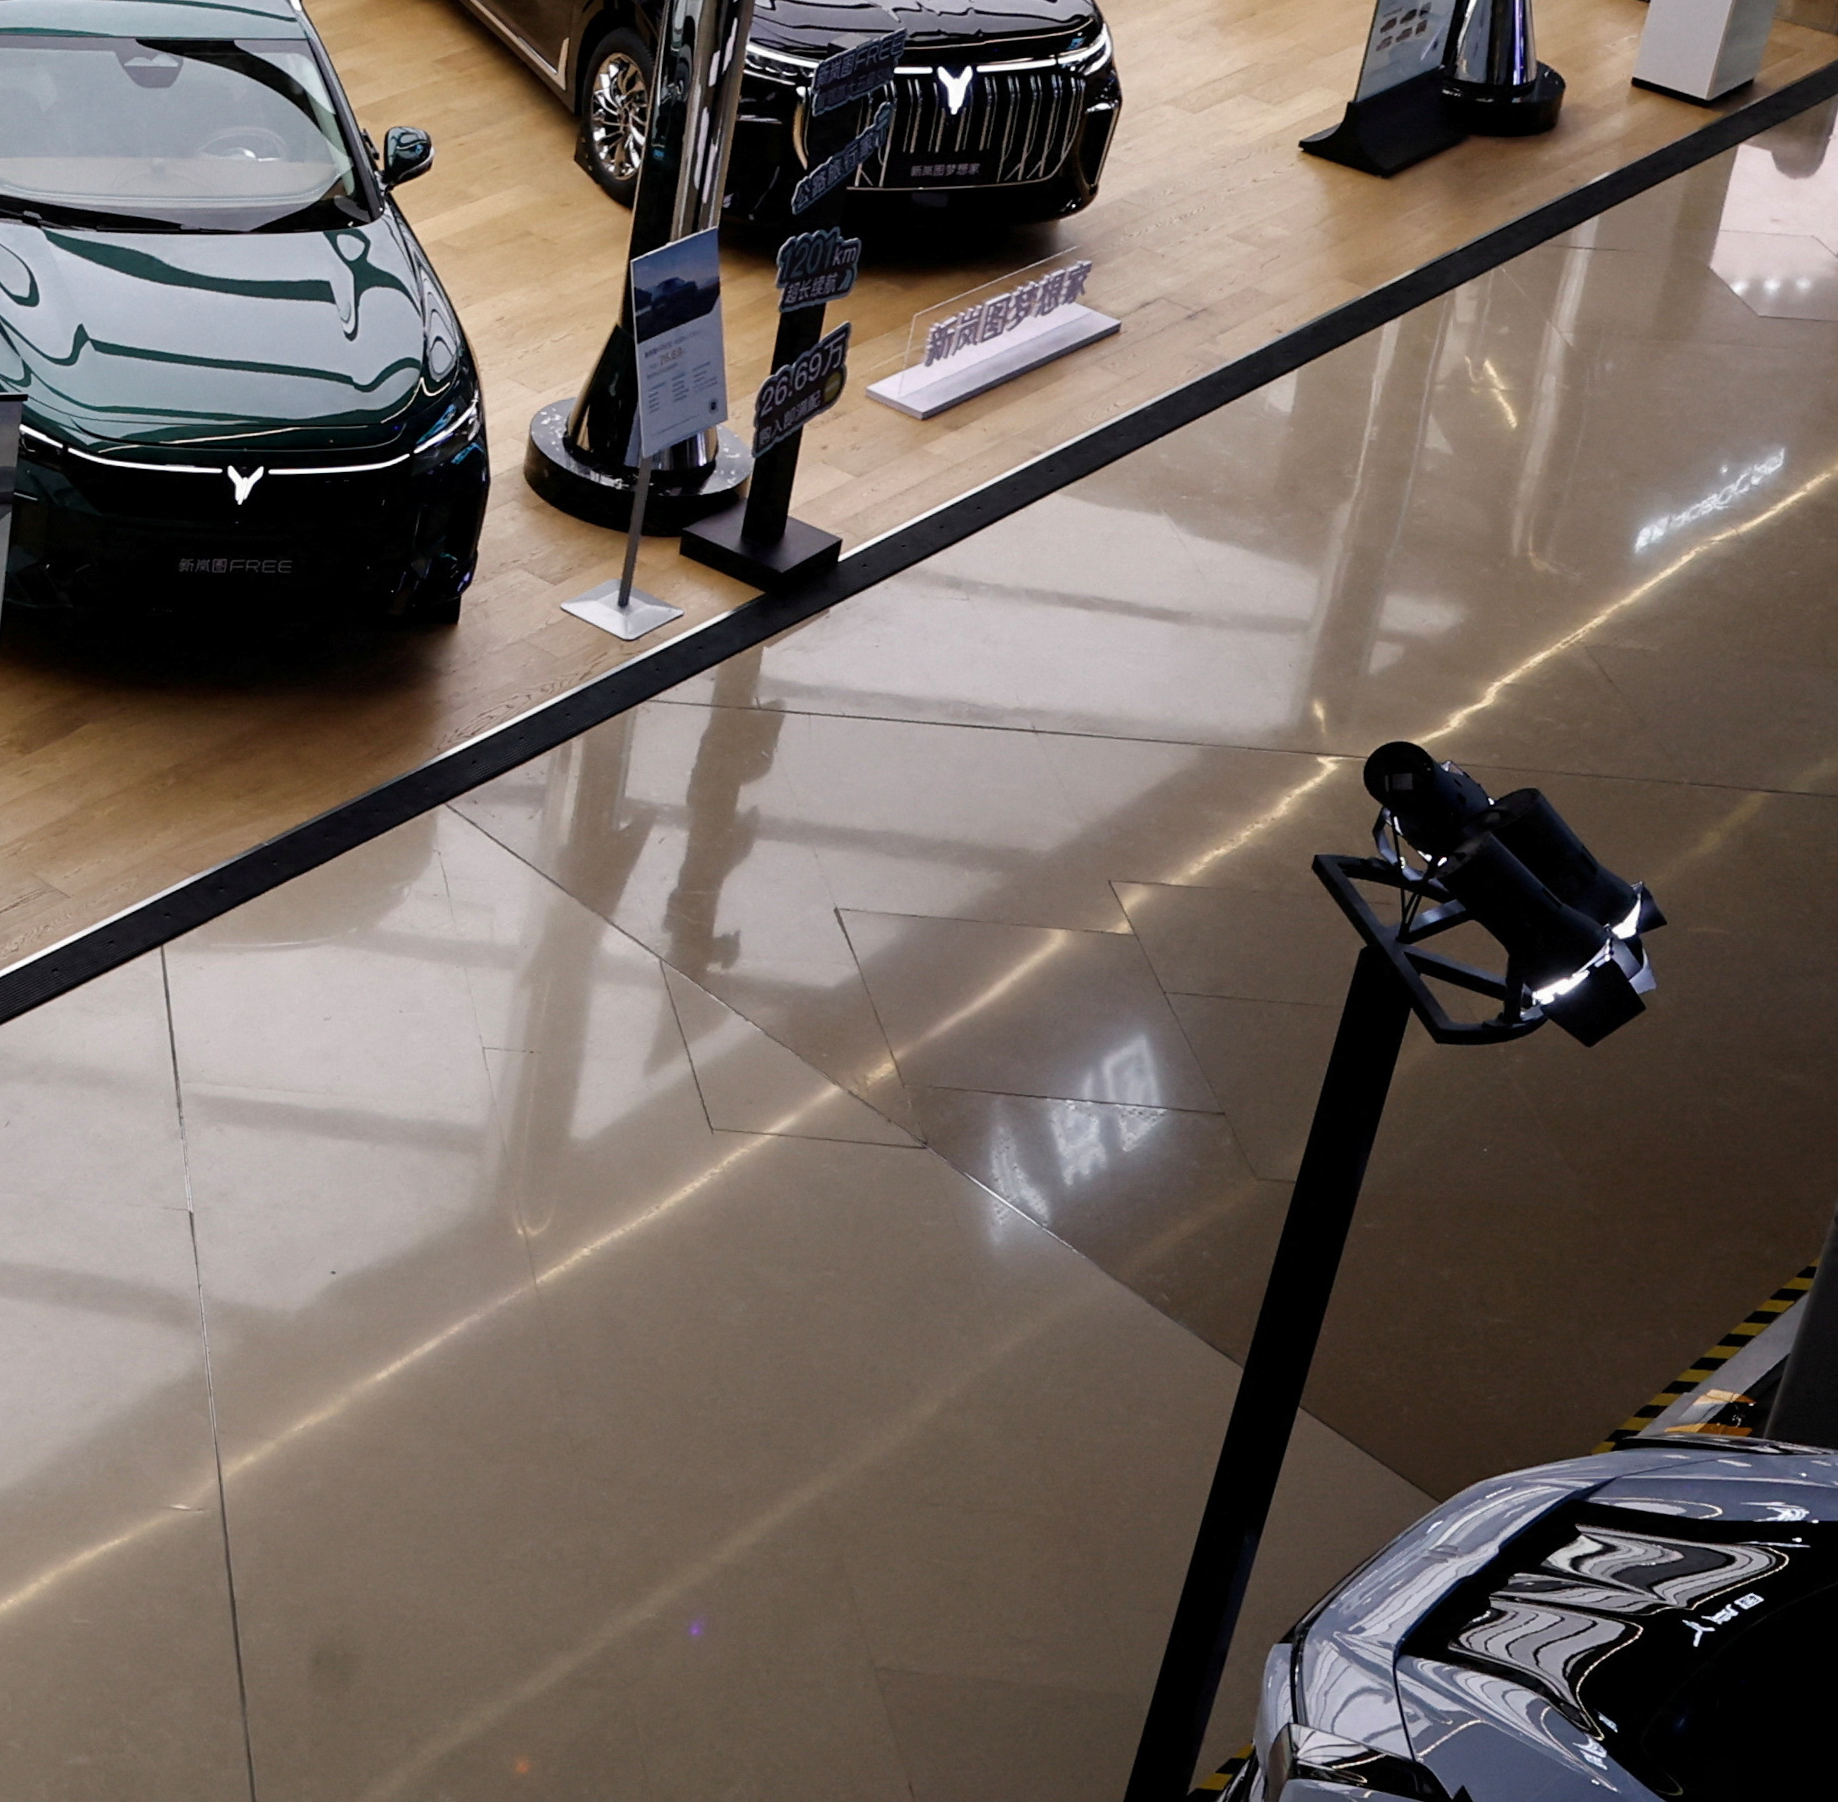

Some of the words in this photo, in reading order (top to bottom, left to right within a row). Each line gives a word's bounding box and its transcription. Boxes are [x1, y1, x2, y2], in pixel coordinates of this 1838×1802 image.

[924, 260, 1093, 367] 新岚图梦想家
[178, 557, 294, 575] 新岚图FREE
